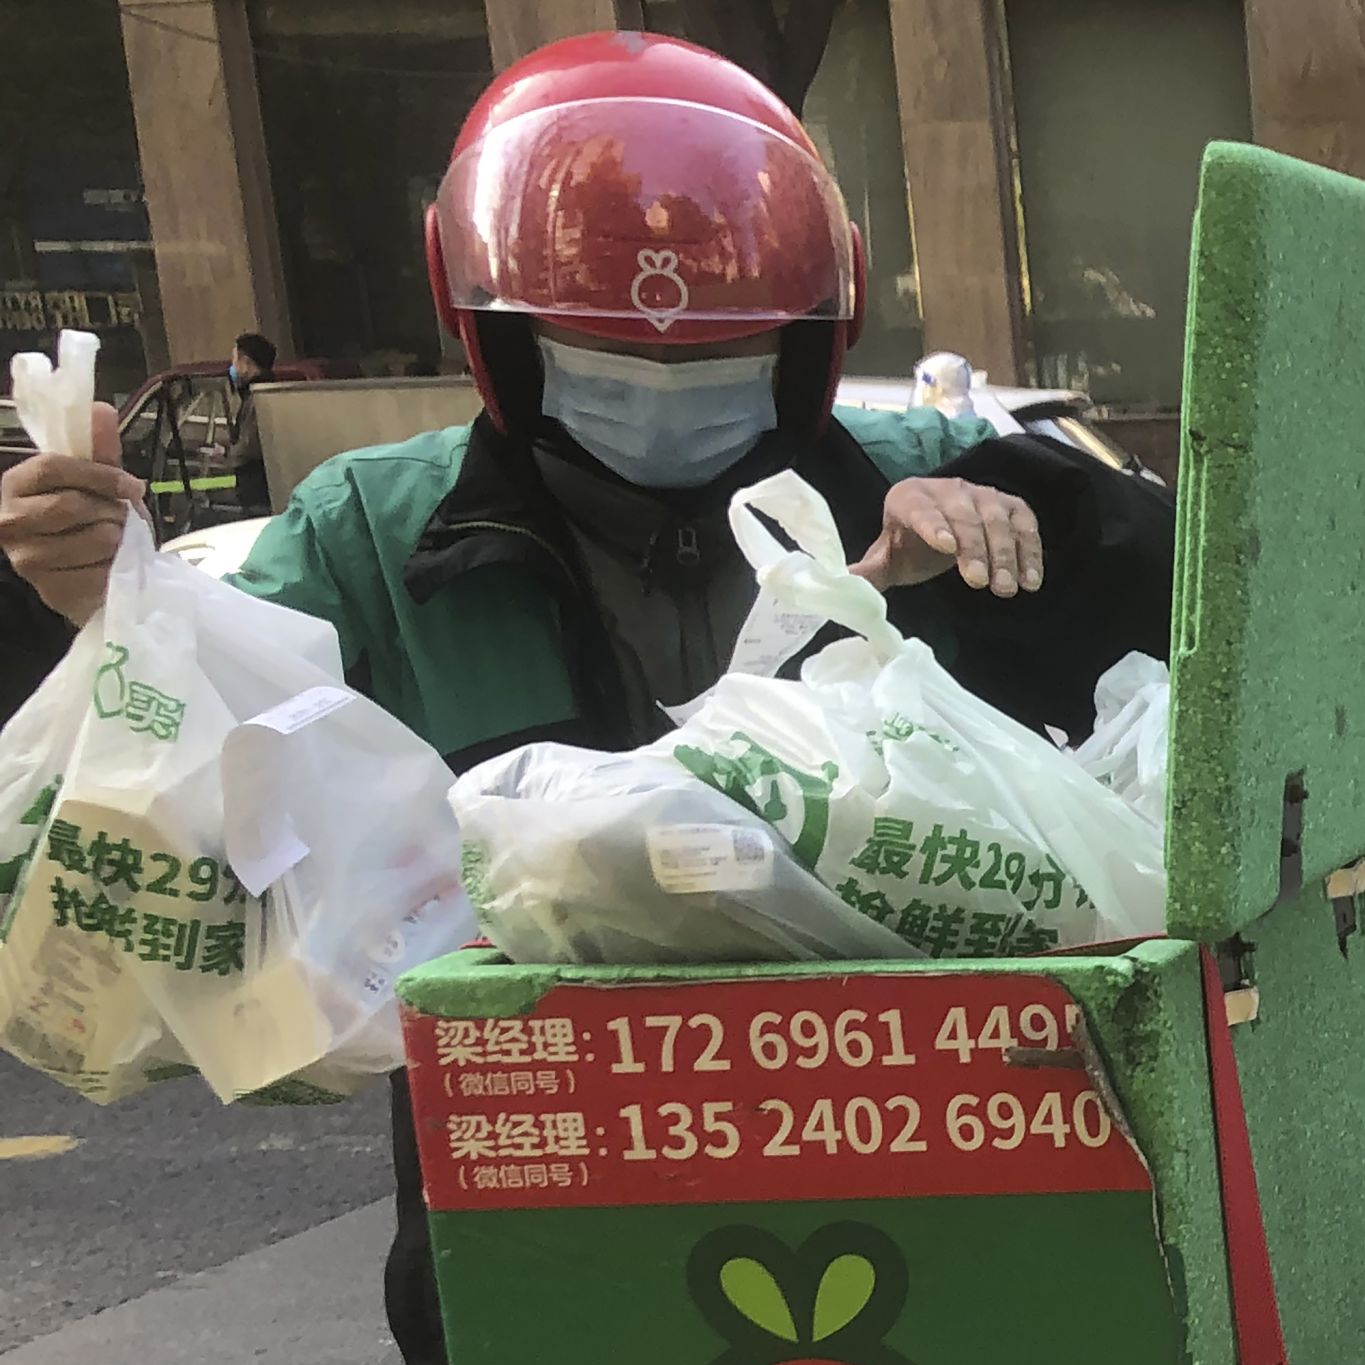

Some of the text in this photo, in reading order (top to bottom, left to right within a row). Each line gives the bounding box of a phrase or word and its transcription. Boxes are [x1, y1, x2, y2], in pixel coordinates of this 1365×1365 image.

[608, 1012, 732, 1075] 172
[750, 1007, 917, 1070] 6961
[622, 1101, 742, 1162] 135
[761, 1096, 928, 1156] 2402
[945, 1090, 1112, 1151] 6940
